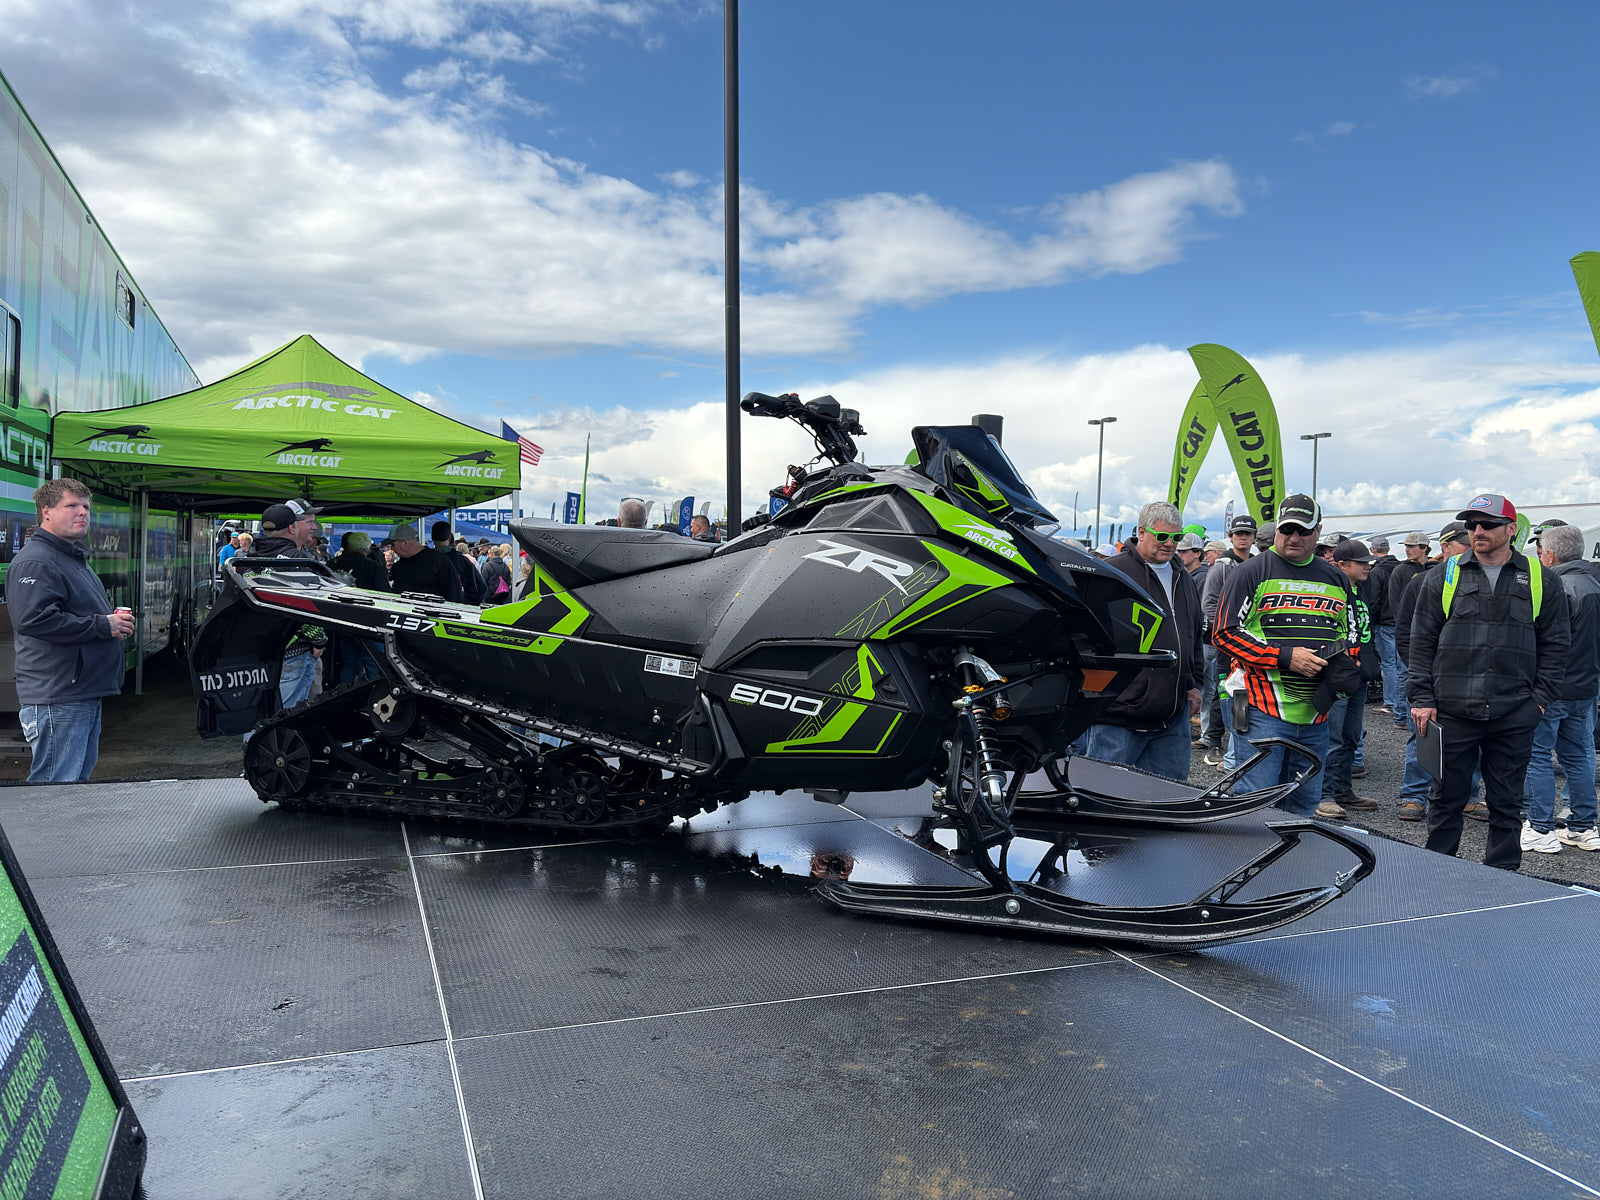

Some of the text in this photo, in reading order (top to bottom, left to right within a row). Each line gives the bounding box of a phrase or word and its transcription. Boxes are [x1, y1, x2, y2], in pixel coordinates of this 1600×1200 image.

[232, 394, 399, 419] ARCTIC CAT
[1183, 416, 1208, 458] CAT
[88, 440, 161, 456] ARCTIC CAT
[276, 453, 342, 468] ARCTIC CAT
[1230, 410, 1275, 522] RCTIC CAT
[444, 465, 504, 479] ARCTIC CAT
[444, 512, 513, 521] OLARIS
[964, 530, 1018, 559] ARCTIC CAT
[801, 539, 914, 596] ZR
[1060, 562, 1097, 572] CATALYST
[1279, 581, 1327, 593] TEAM
[1257, 594, 1346, 615] ARCTIC
[386, 614, 436, 632] 137
[471, 630, 532, 645] PERFORMANCE
[730, 683, 823, 716] 600
